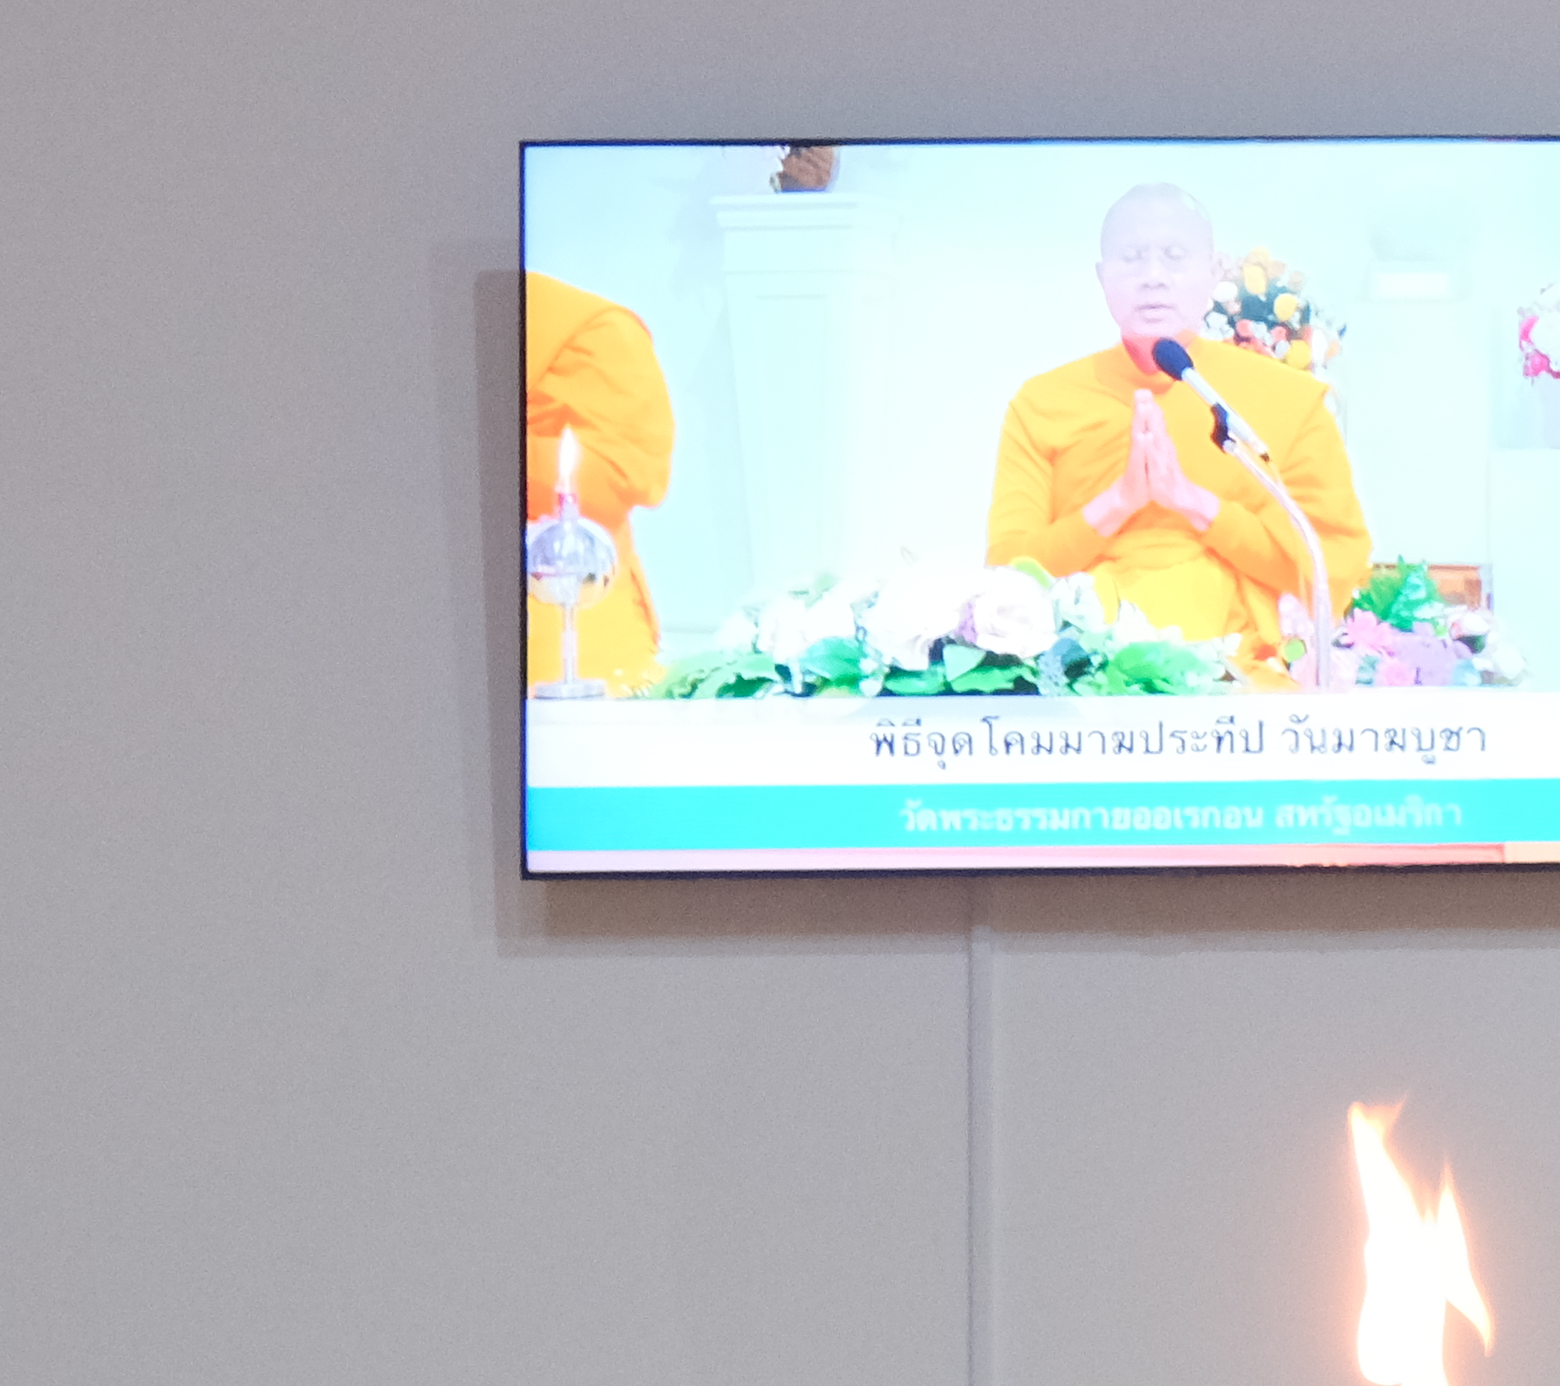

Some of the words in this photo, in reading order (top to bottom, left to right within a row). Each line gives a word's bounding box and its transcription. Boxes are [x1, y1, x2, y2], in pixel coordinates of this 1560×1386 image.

[869, 715, 1264, 770] พิธีจุดโคมมาฆประทีป
[1281, 713, 1487, 765] วันมาฆบูชา
